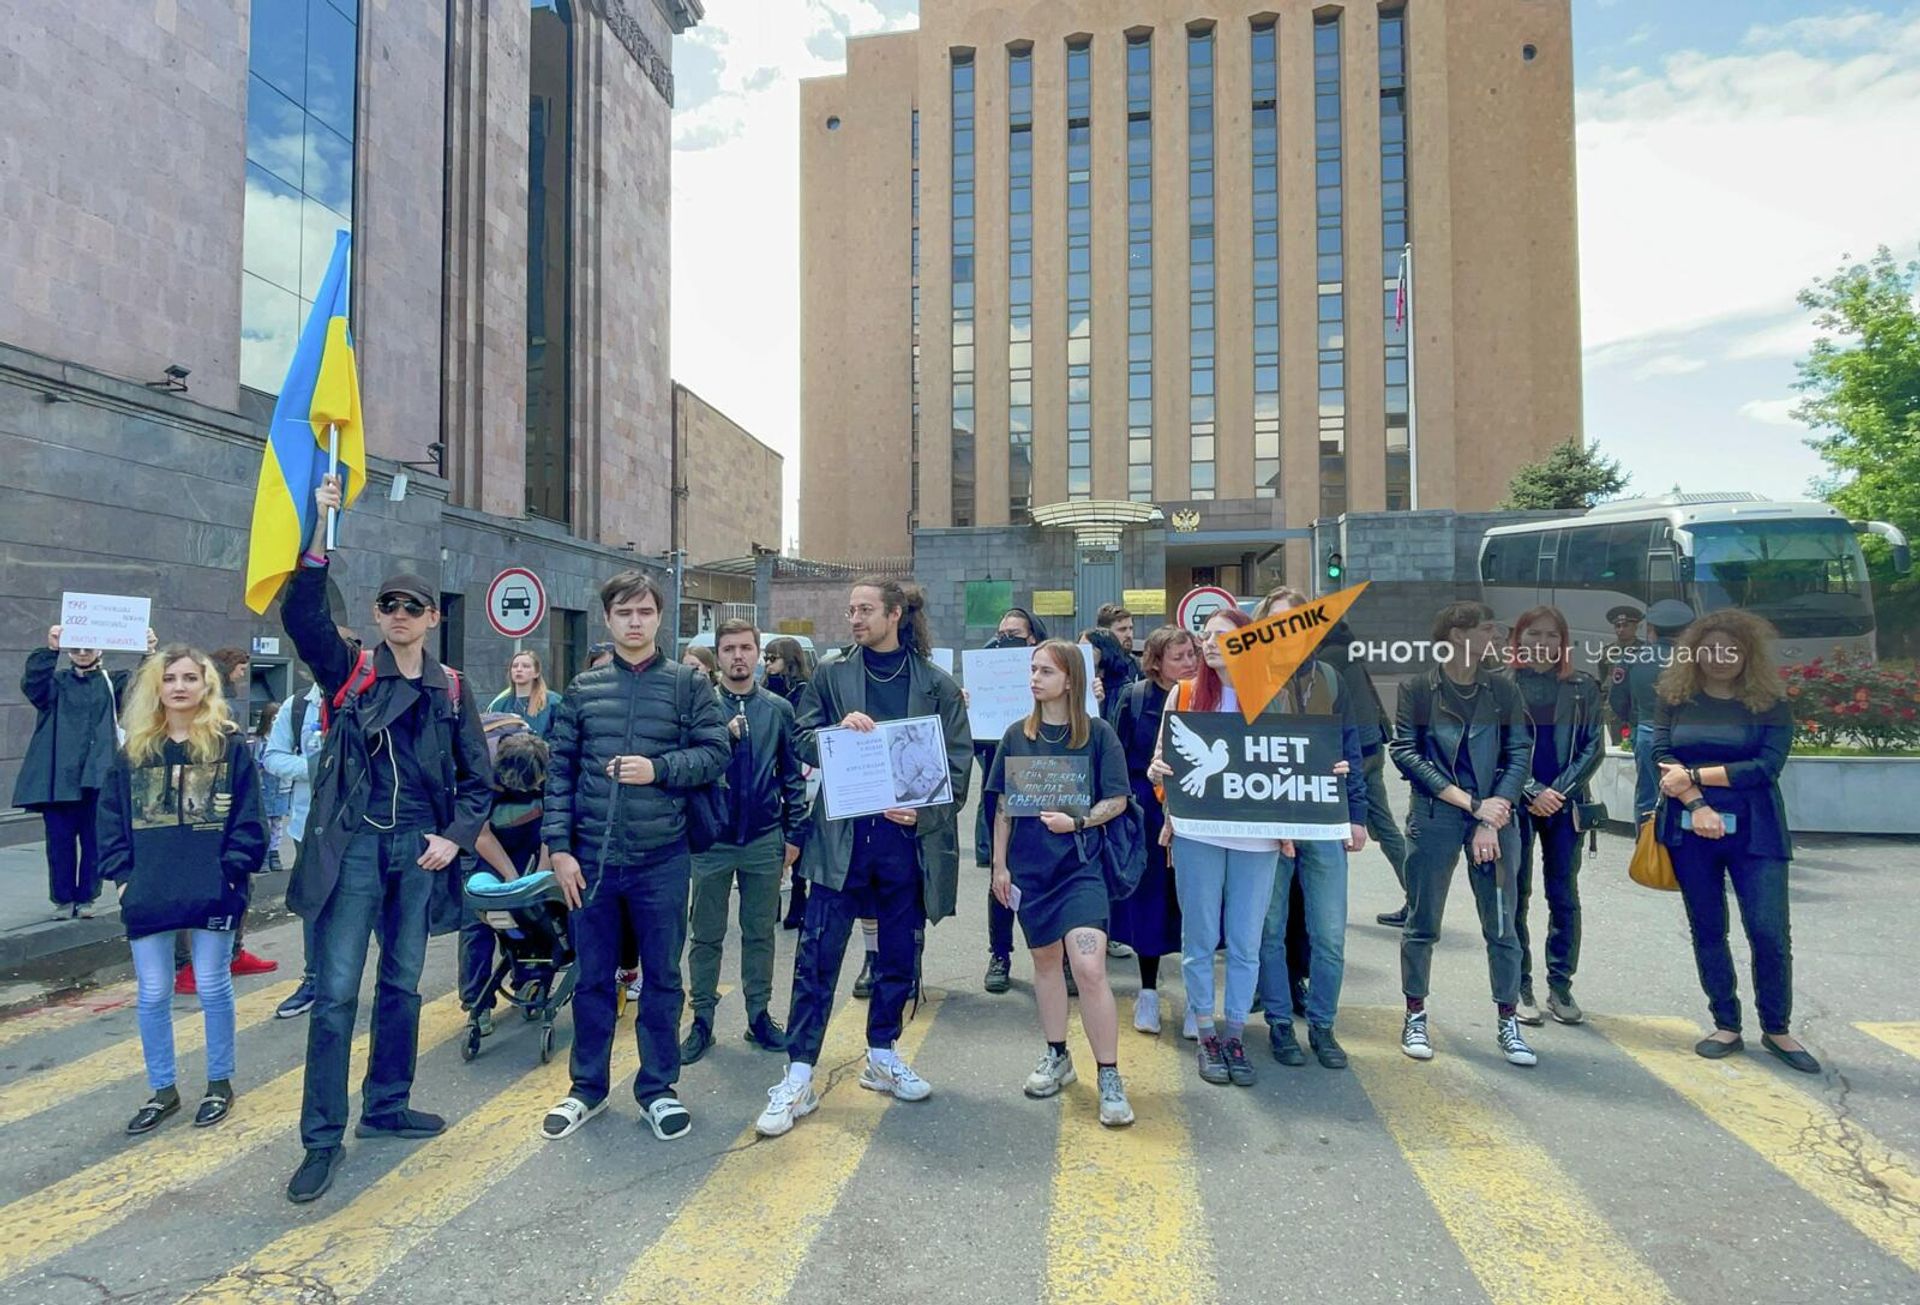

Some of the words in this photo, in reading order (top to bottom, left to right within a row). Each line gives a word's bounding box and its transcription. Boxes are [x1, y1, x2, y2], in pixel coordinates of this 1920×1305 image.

[65, 615, 88, 626] 2022
[1244, 735, 1310, 764] НЕТ
[1222, 766, 1340, 803] ВОЙНЕ
